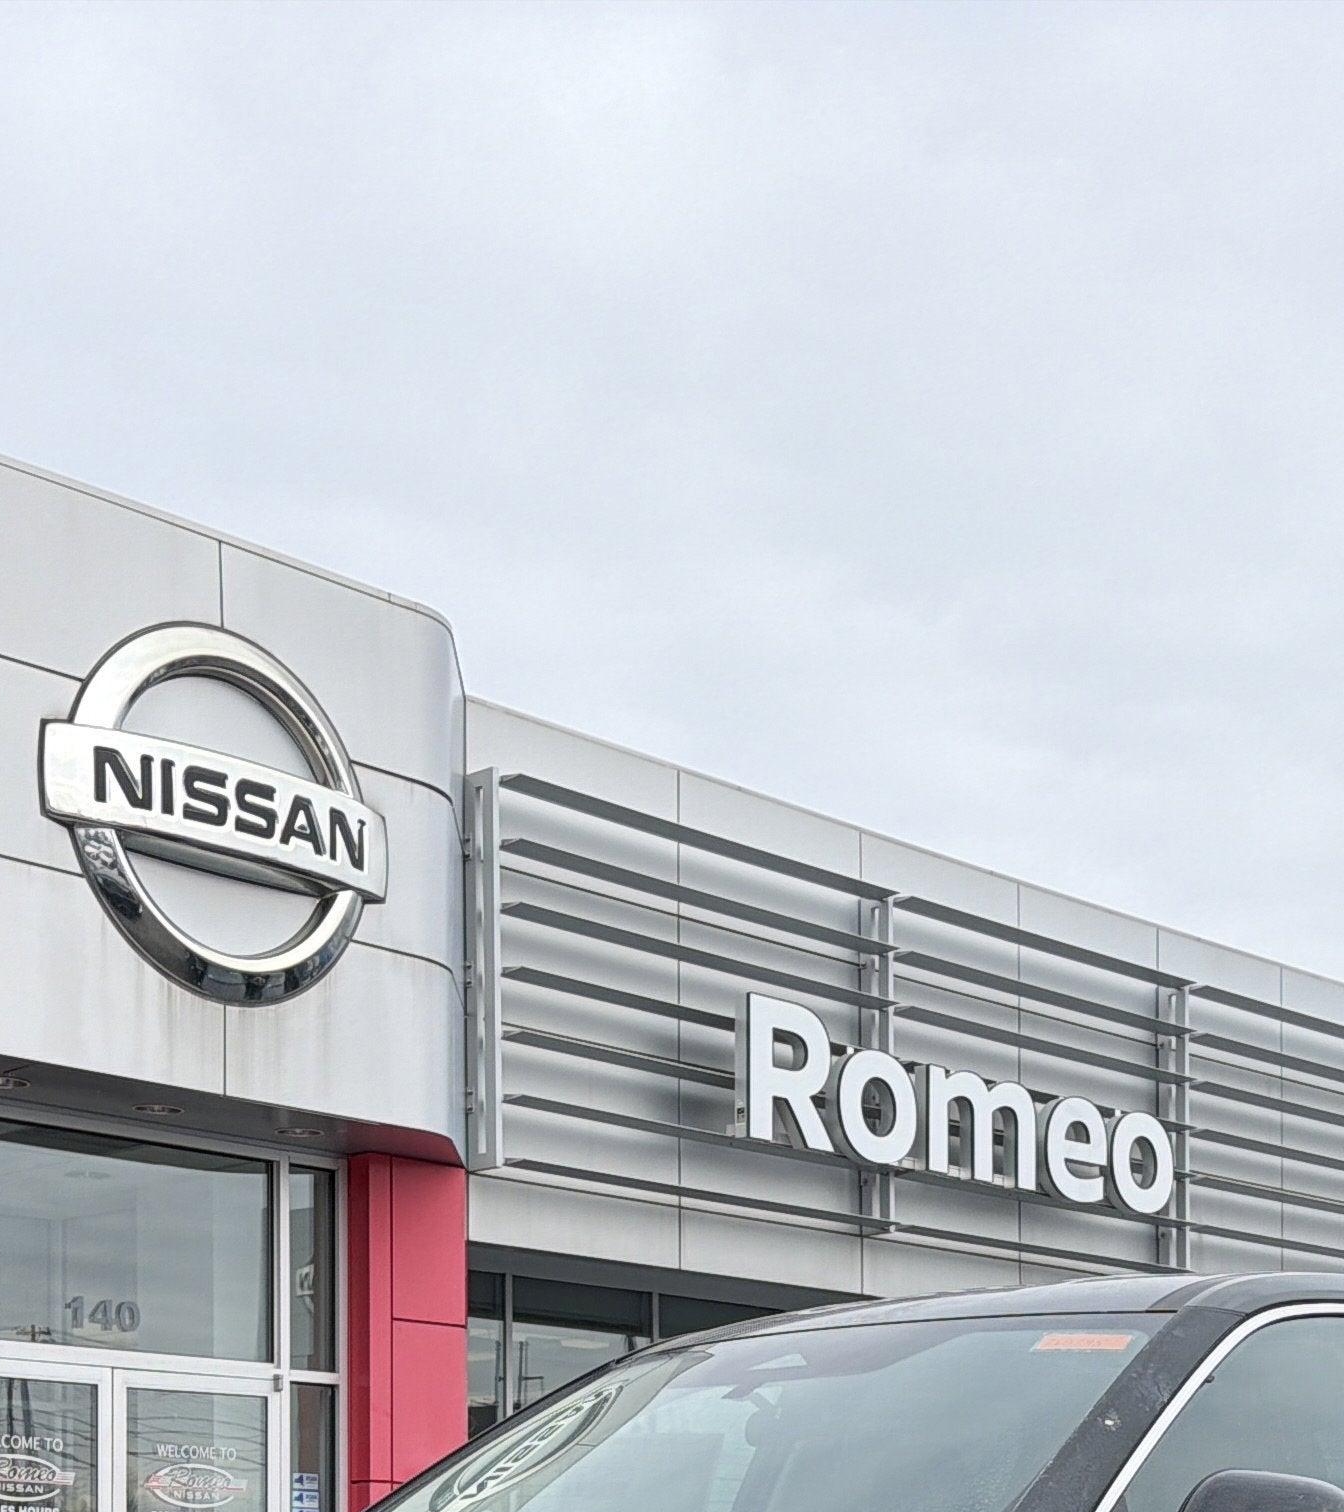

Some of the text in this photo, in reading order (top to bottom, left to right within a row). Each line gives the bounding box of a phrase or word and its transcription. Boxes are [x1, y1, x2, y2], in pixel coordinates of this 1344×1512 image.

[93, 745, 367, 873] NISSAN
[741, 991, 1175, 1214] Romeo
[64, 1295, 141, 1332] 140
[43, 1437, 64, 1451] TO
[156, 1443, 237, 1461] WELCOME TO
[173, 1489, 220, 1501] NISSAN
